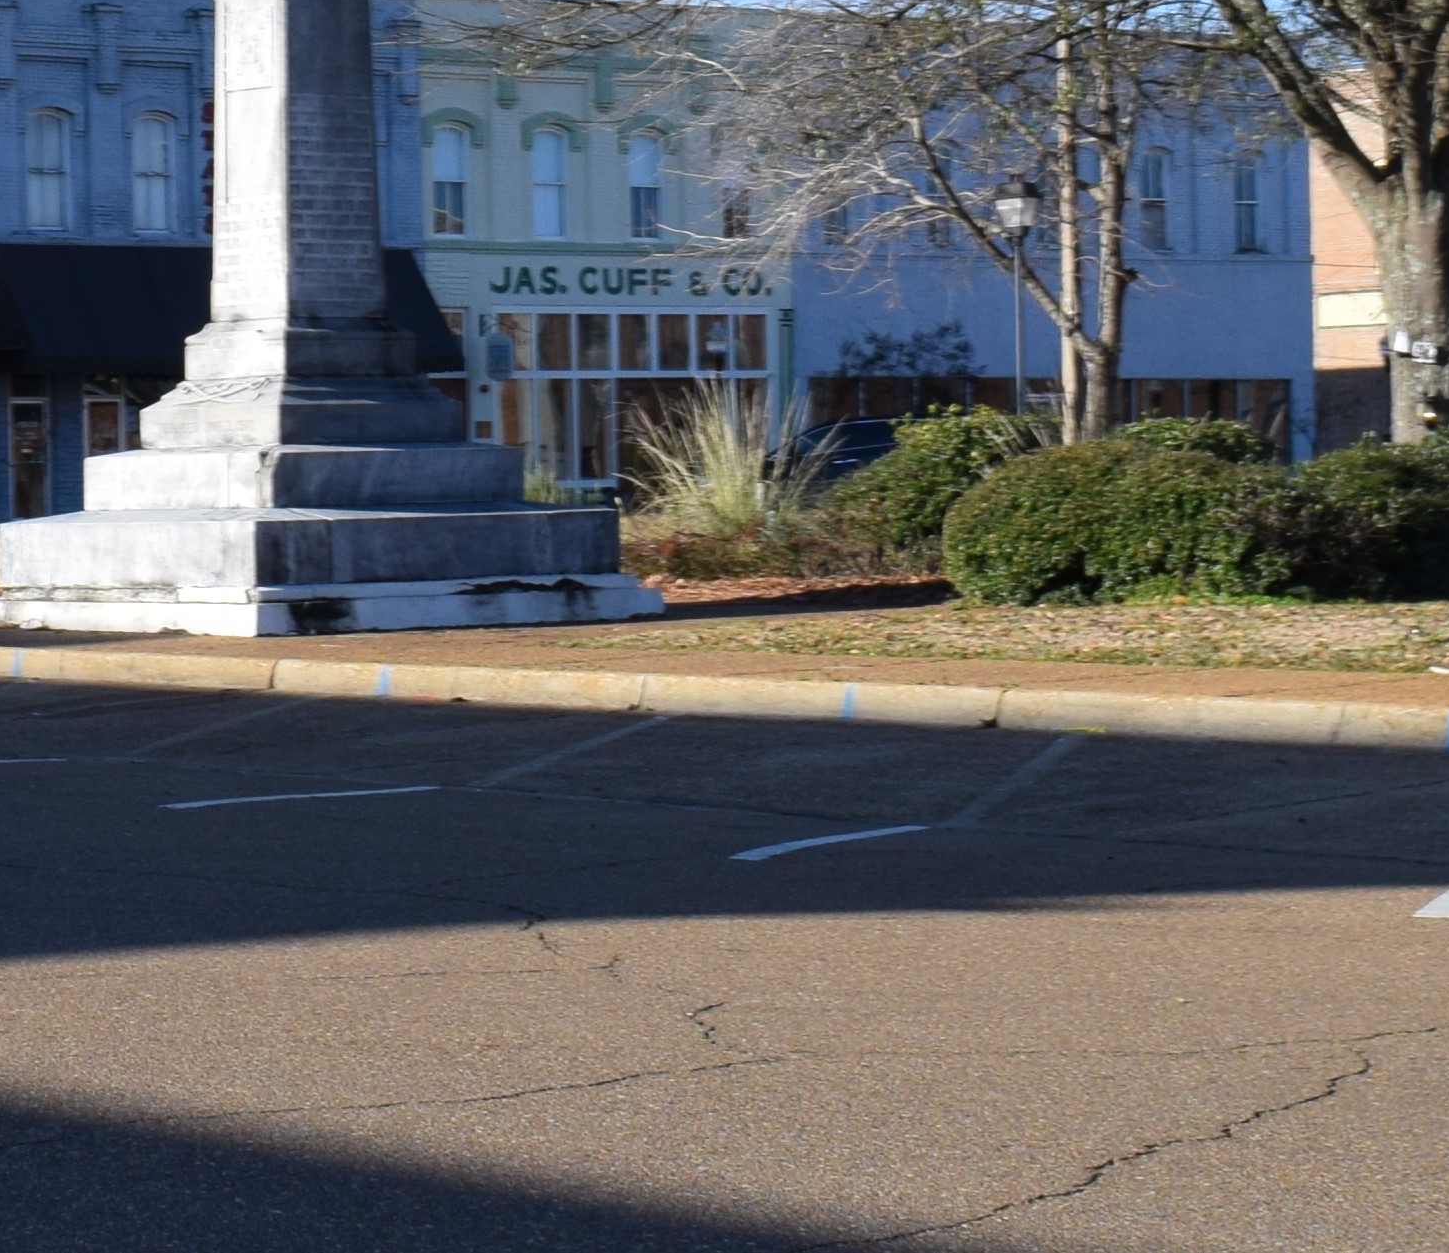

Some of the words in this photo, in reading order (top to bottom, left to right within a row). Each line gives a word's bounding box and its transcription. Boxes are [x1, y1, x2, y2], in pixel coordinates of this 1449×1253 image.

[489, 266, 567, 295] JAS.
[578, 266, 672, 295] CUFF
[688, 270, 709, 297] &
[722, 268, 772, 296] CO.
